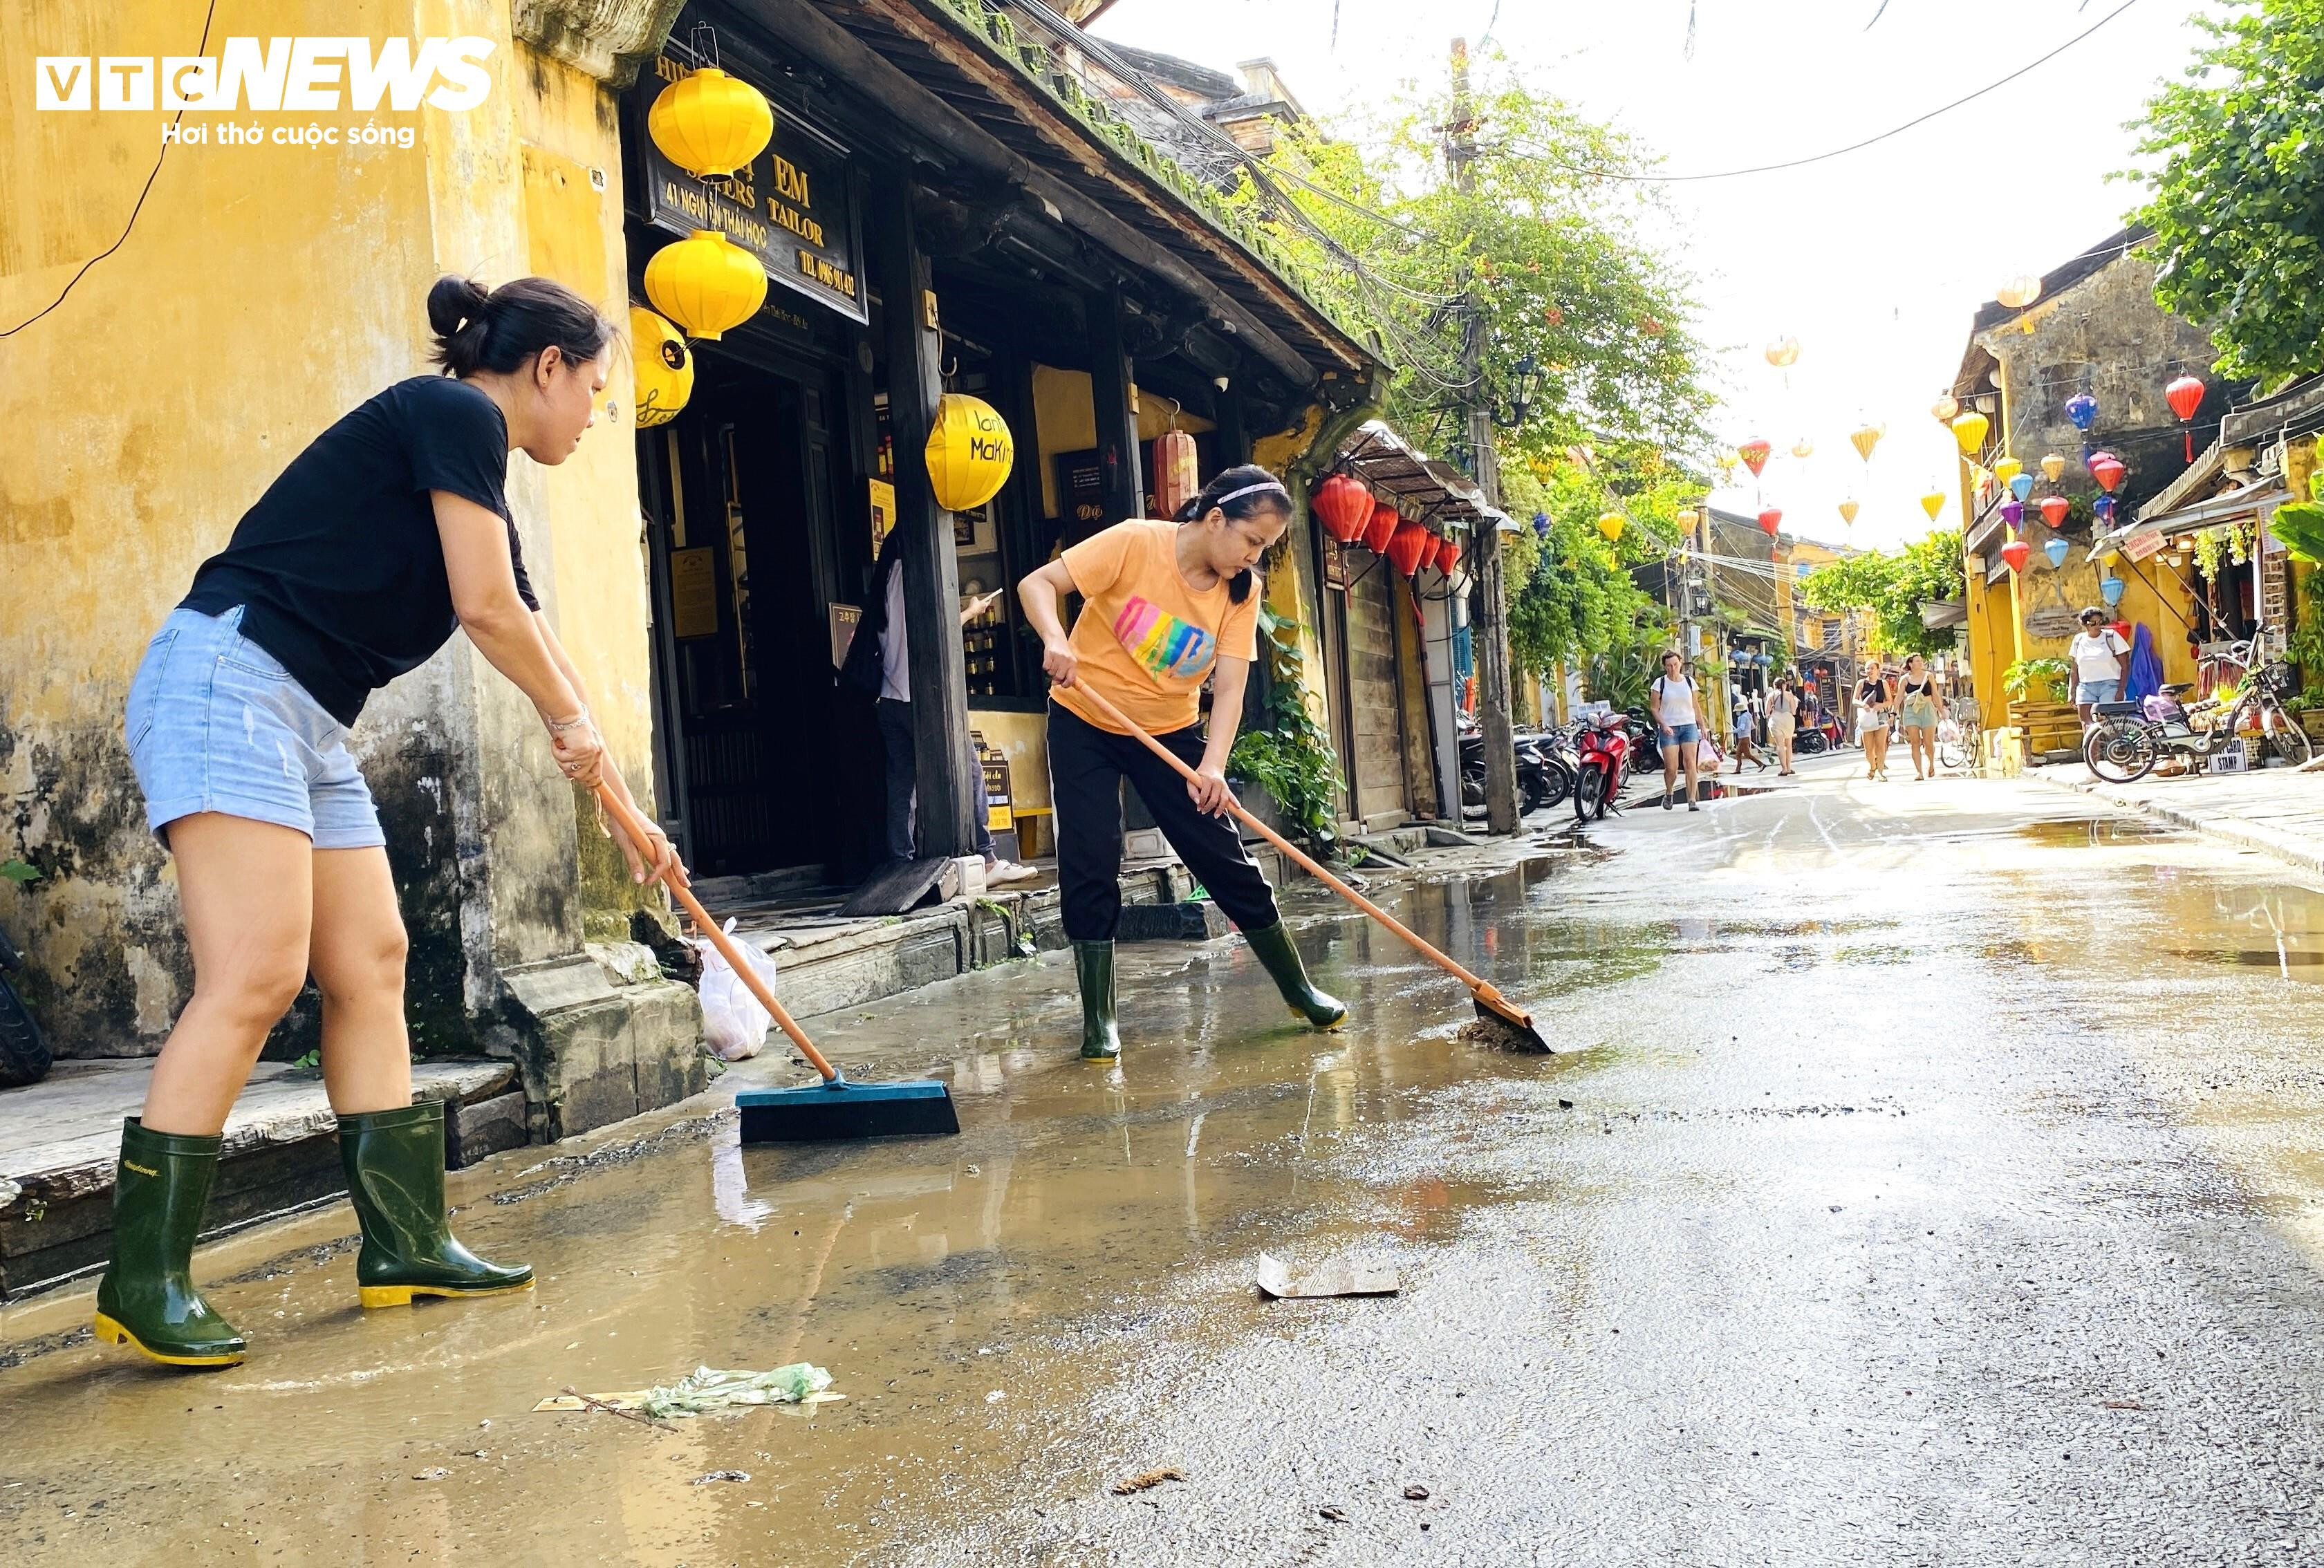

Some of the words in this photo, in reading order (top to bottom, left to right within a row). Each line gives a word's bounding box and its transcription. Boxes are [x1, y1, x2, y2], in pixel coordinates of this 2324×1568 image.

[772, 153, 810, 209] EM
[723, 206, 745, 239] THÁI
[746, 218, 768, 251] HỌC
[766, 196, 825, 248] TAILOR
[2218, 756, 2237, 770] STAMP
